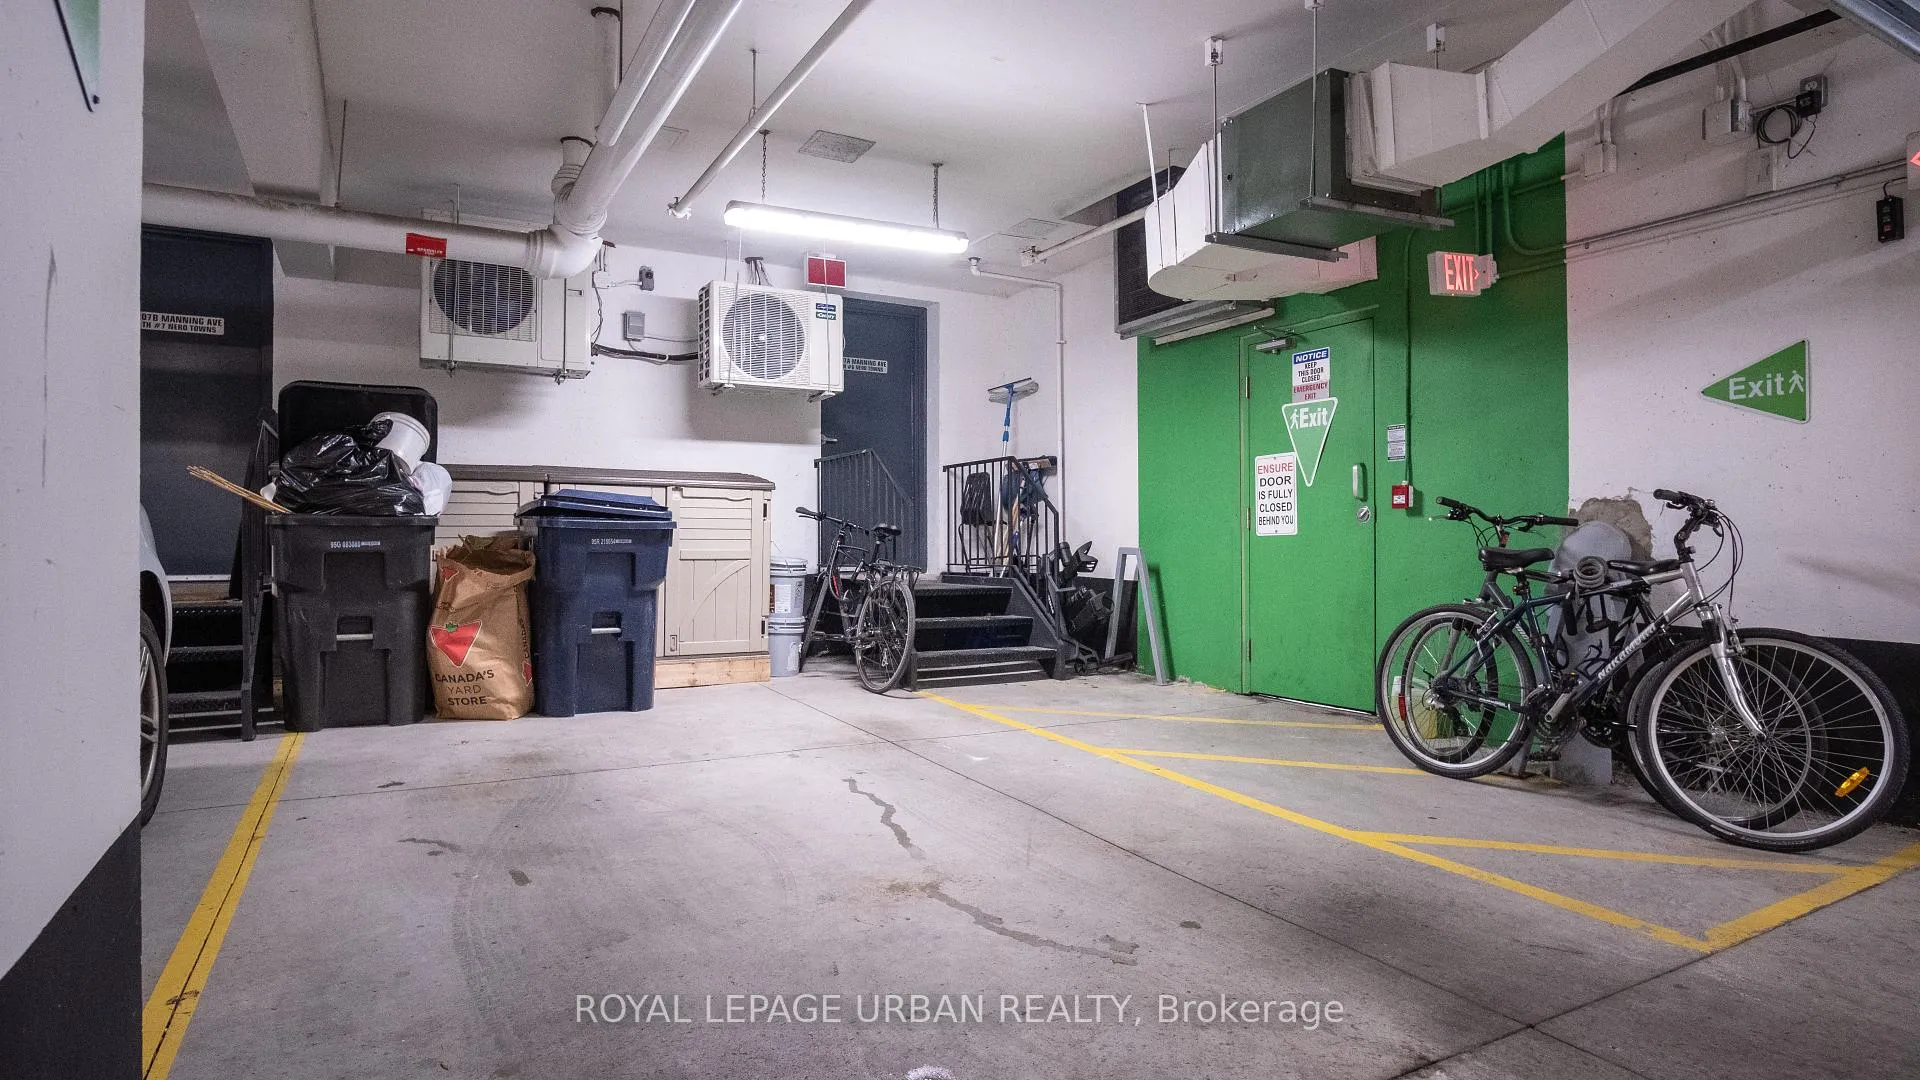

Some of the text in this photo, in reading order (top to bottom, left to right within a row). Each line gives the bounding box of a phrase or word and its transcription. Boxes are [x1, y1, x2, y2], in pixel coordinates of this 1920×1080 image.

[1444, 254, 1474, 292] EXIT
[161, 314, 204, 325] MANNING
[206, 318, 223, 327] AVE
[190, 325, 217, 333] TOWNS
[1295, 350, 1327, 363] NOTICE
[1304, 361, 1317, 369] KEEP
[1298, 367, 1324, 377] THIS DOOR
[1301, 374, 1321, 383] CLOSED
[1293, 382, 1328, 393] EMERGENCY
[1728, 372, 1785, 401] Exit
[1299, 407, 1328, 429] Exit
[1257, 462, 1293, 475] ENSURE
[1259, 475, 1291, 487] DOOR
[1258, 488, 1293, 500] IS FULLY
[1259, 501, 1293, 513] CLOSED
[1258, 515, 1294, 526] BEHIND YOU
[435, 669, 495, 684] CANADA'S
[448, 684, 482, 695] YARD
[447, 695, 488, 706] STORE
